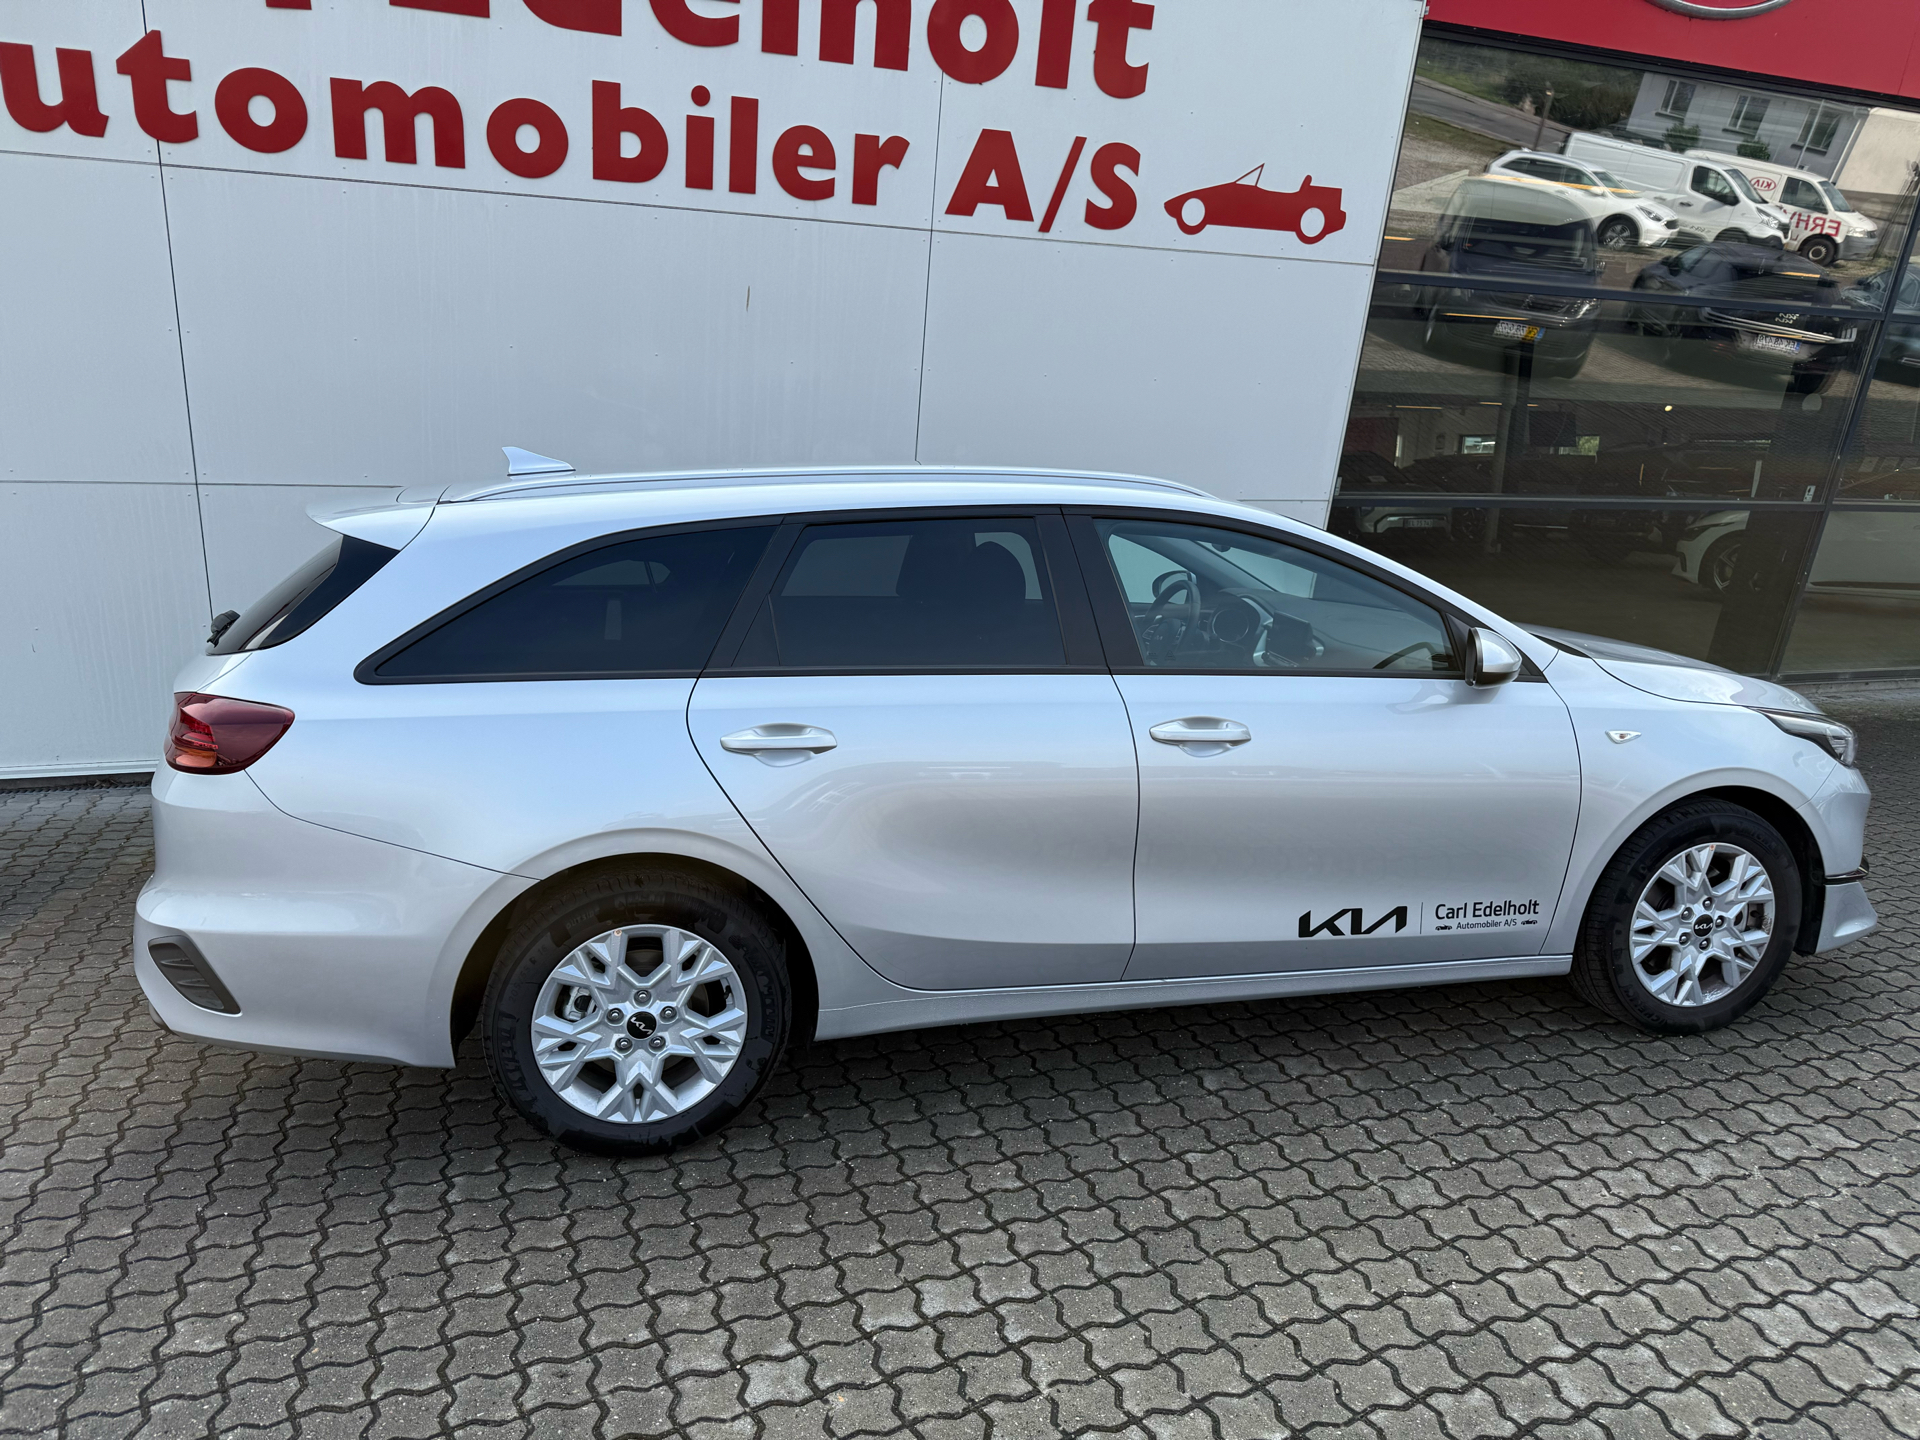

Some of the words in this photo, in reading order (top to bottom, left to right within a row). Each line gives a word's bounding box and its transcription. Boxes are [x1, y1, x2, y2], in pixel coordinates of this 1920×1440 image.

[945, 128, 1141, 233] A/S
[1298, 906, 1408, 938] KIA
[1435, 902, 1468, 920] Carl
[1472, 899, 1540, 918] Edelholt
[1456, 920, 1502, 930] Automobiler
[1503, 918, 1518, 927] A/S
